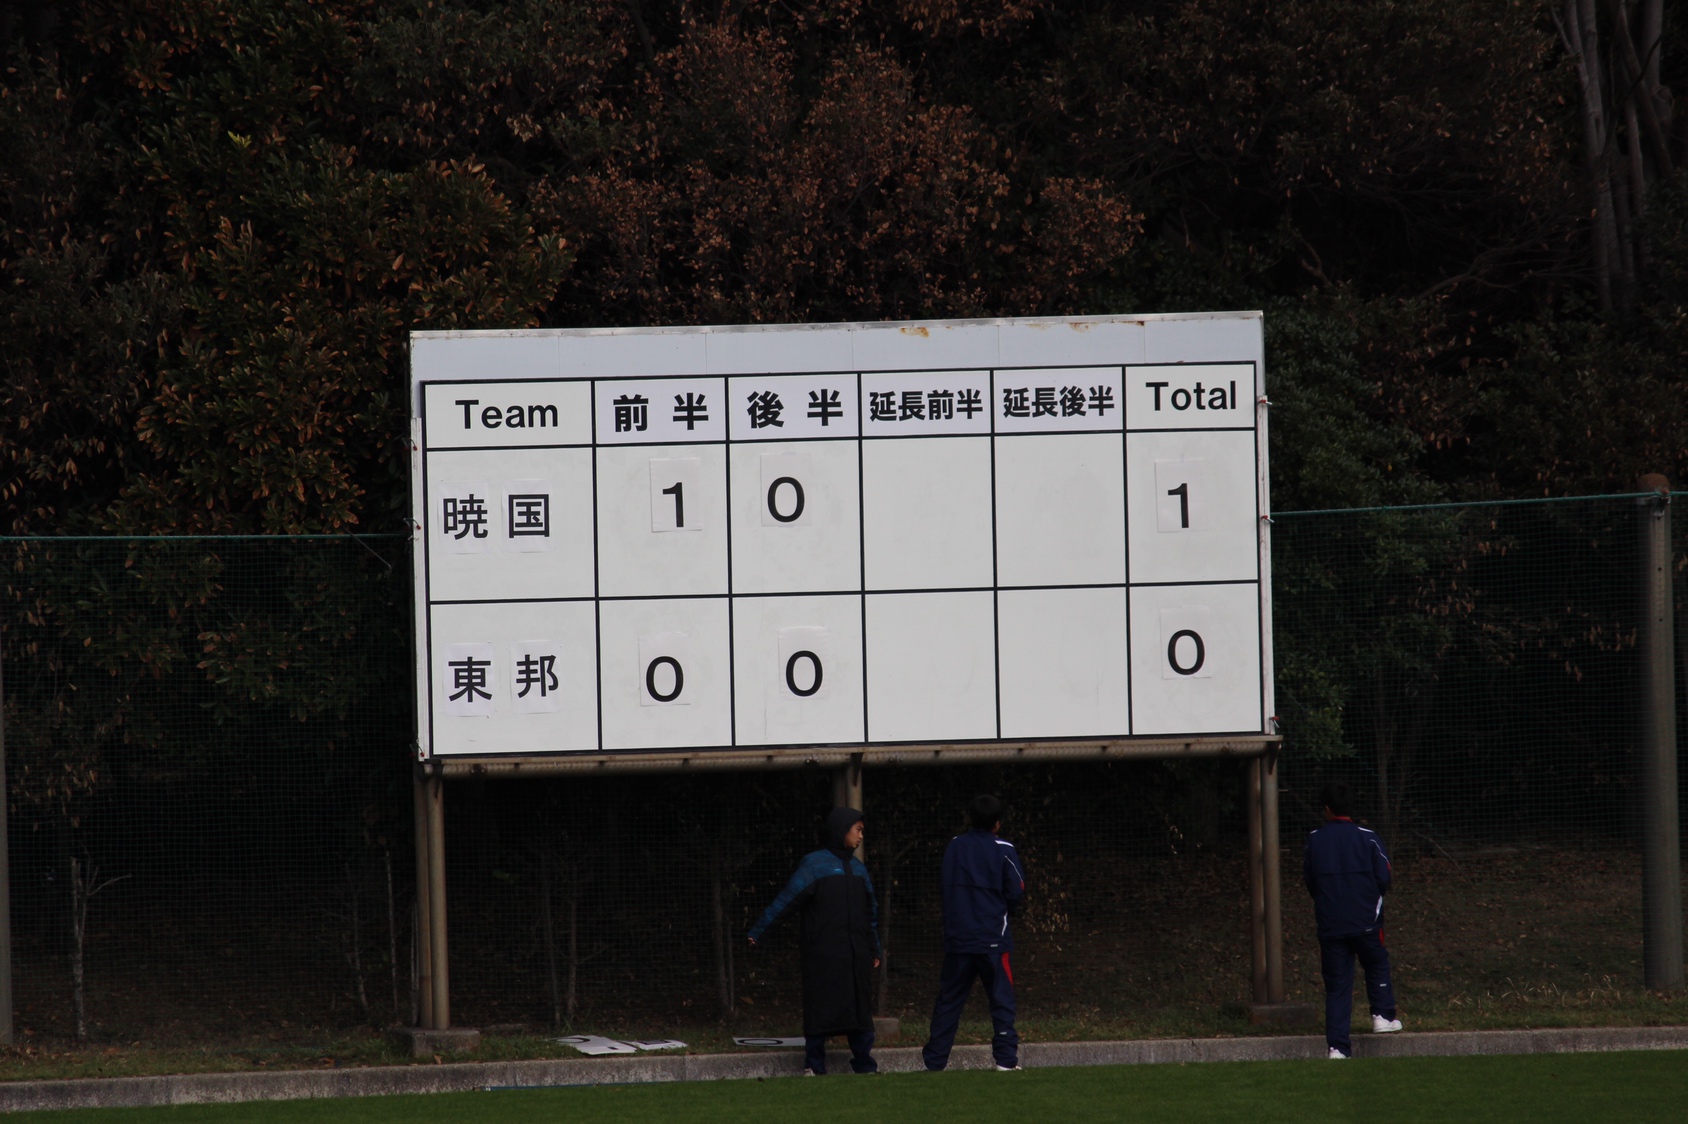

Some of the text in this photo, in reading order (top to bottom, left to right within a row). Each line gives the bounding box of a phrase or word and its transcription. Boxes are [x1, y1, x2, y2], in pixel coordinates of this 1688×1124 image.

[455, 400, 558, 429] Team
[870, 389, 983, 421] 延長前半
[1003, 386, 1115, 418] 延長後半
[1146, 381, 1237, 411] Total
[662, 482, 684, 528] 1
[767, 477, 805, 522] 0
[1167, 482, 1189, 528] 1
[785, 650, 823, 697] 0
[1167, 629, 1205, 675] 0
[646, 656, 684, 702] 0
